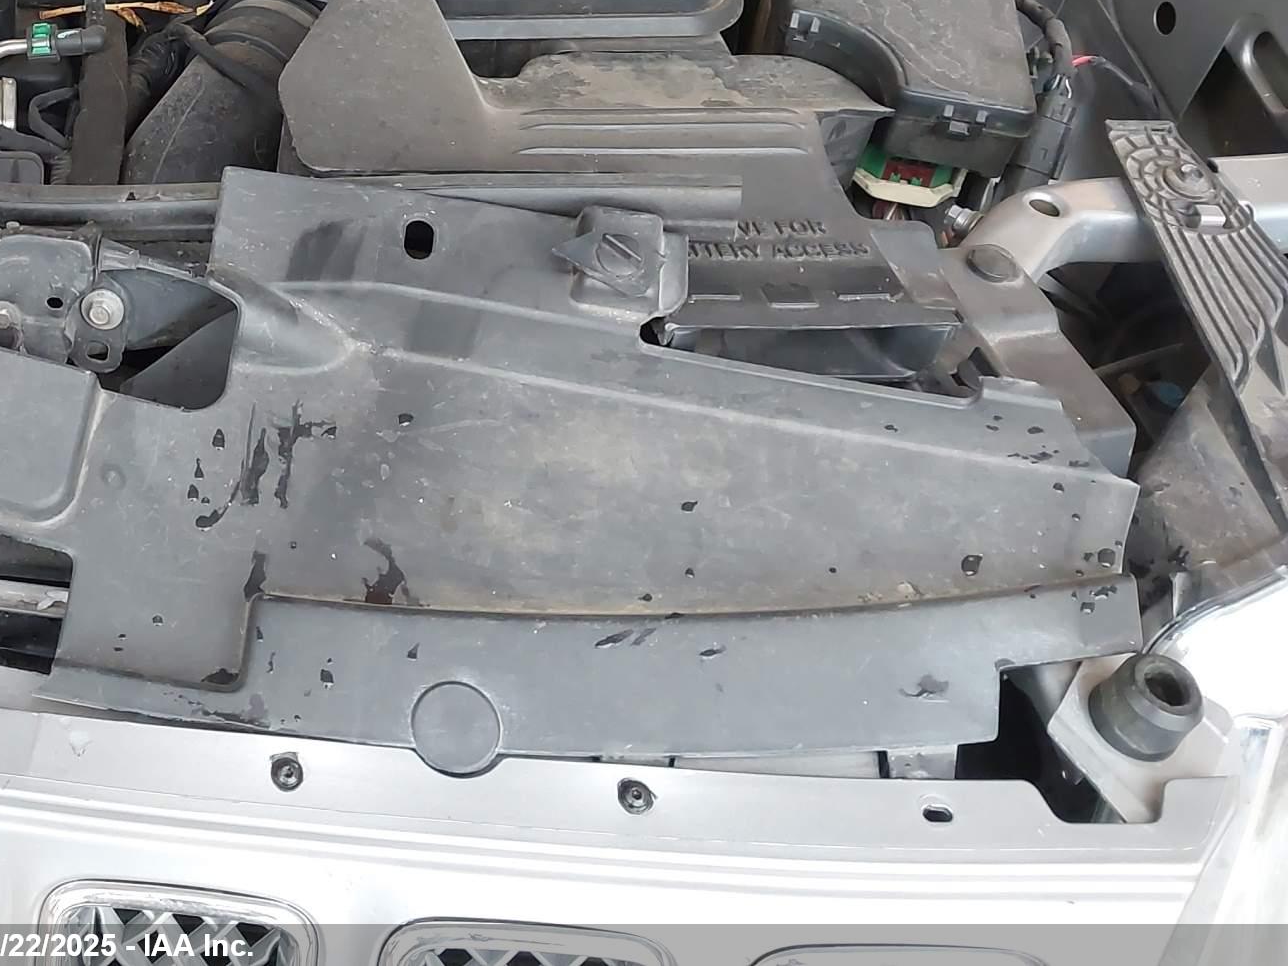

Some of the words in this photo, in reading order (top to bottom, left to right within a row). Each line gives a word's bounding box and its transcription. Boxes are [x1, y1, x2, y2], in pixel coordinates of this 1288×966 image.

[774, 220, 827, 235] FOR
[688, 242, 761, 259] TTERY
[771, 241, 869, 259] ACCESS
